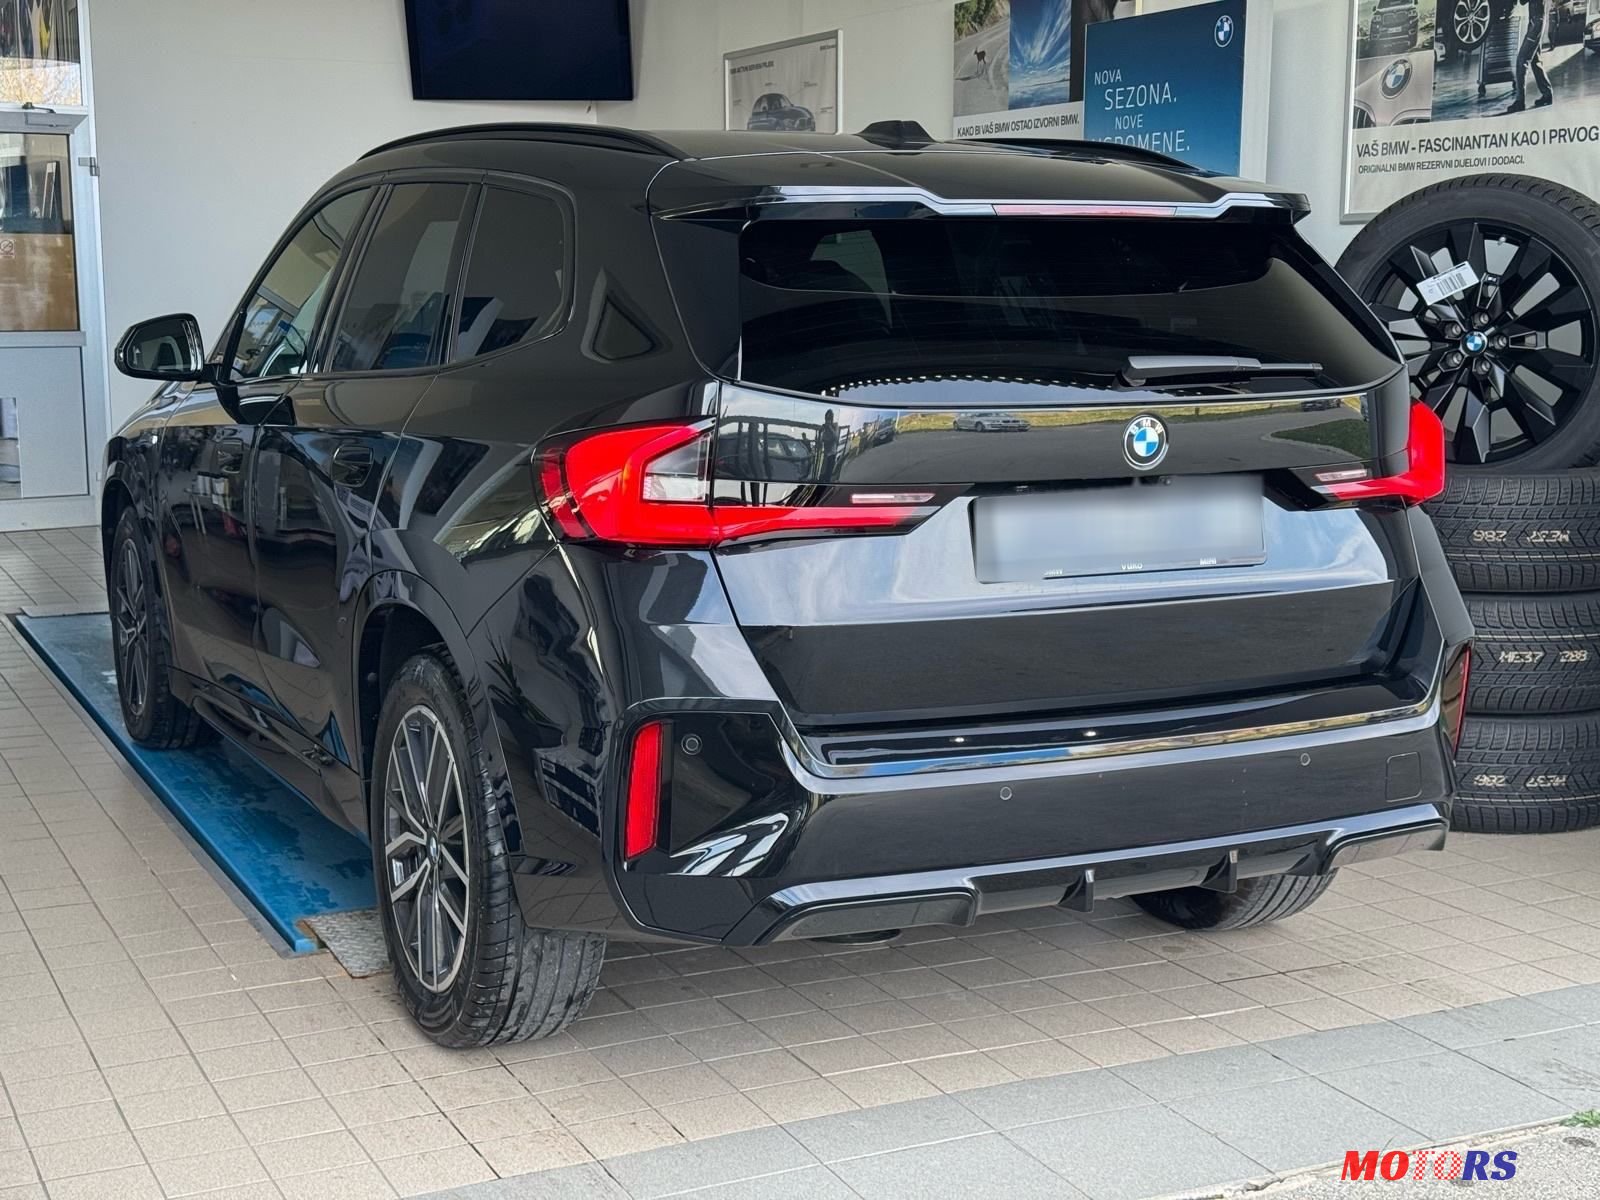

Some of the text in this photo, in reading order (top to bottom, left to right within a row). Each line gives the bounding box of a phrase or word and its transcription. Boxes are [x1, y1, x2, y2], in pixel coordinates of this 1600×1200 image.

[1094, 69, 1122, 86] NOVA
[1104, 81, 1177, 111] SEZONA.
[957, 113, 1080, 138] KAKO BI VAŠ BMW OSTAO IZVORNI BMW.
[1115, 113, 1144, 130] NOVE
[1356, 140, 1379, 158] VAŠ
[1381, 140, 1409, 156] BMW
[1418, 132, 1508, 154] FASCINANTAN
[1511, 130, 1540, 147] KAO
[1542, 129, 1546, 145] I
[1358, 163, 1397, 175] ORIGINALNI
[1397, 161, 1416, 172] BMW
[1416, 159, 1453, 171] REZERVNI
[1454, 157, 1487, 169] DIJELOVI
[1491, 155, 1525, 166] DODACI.
